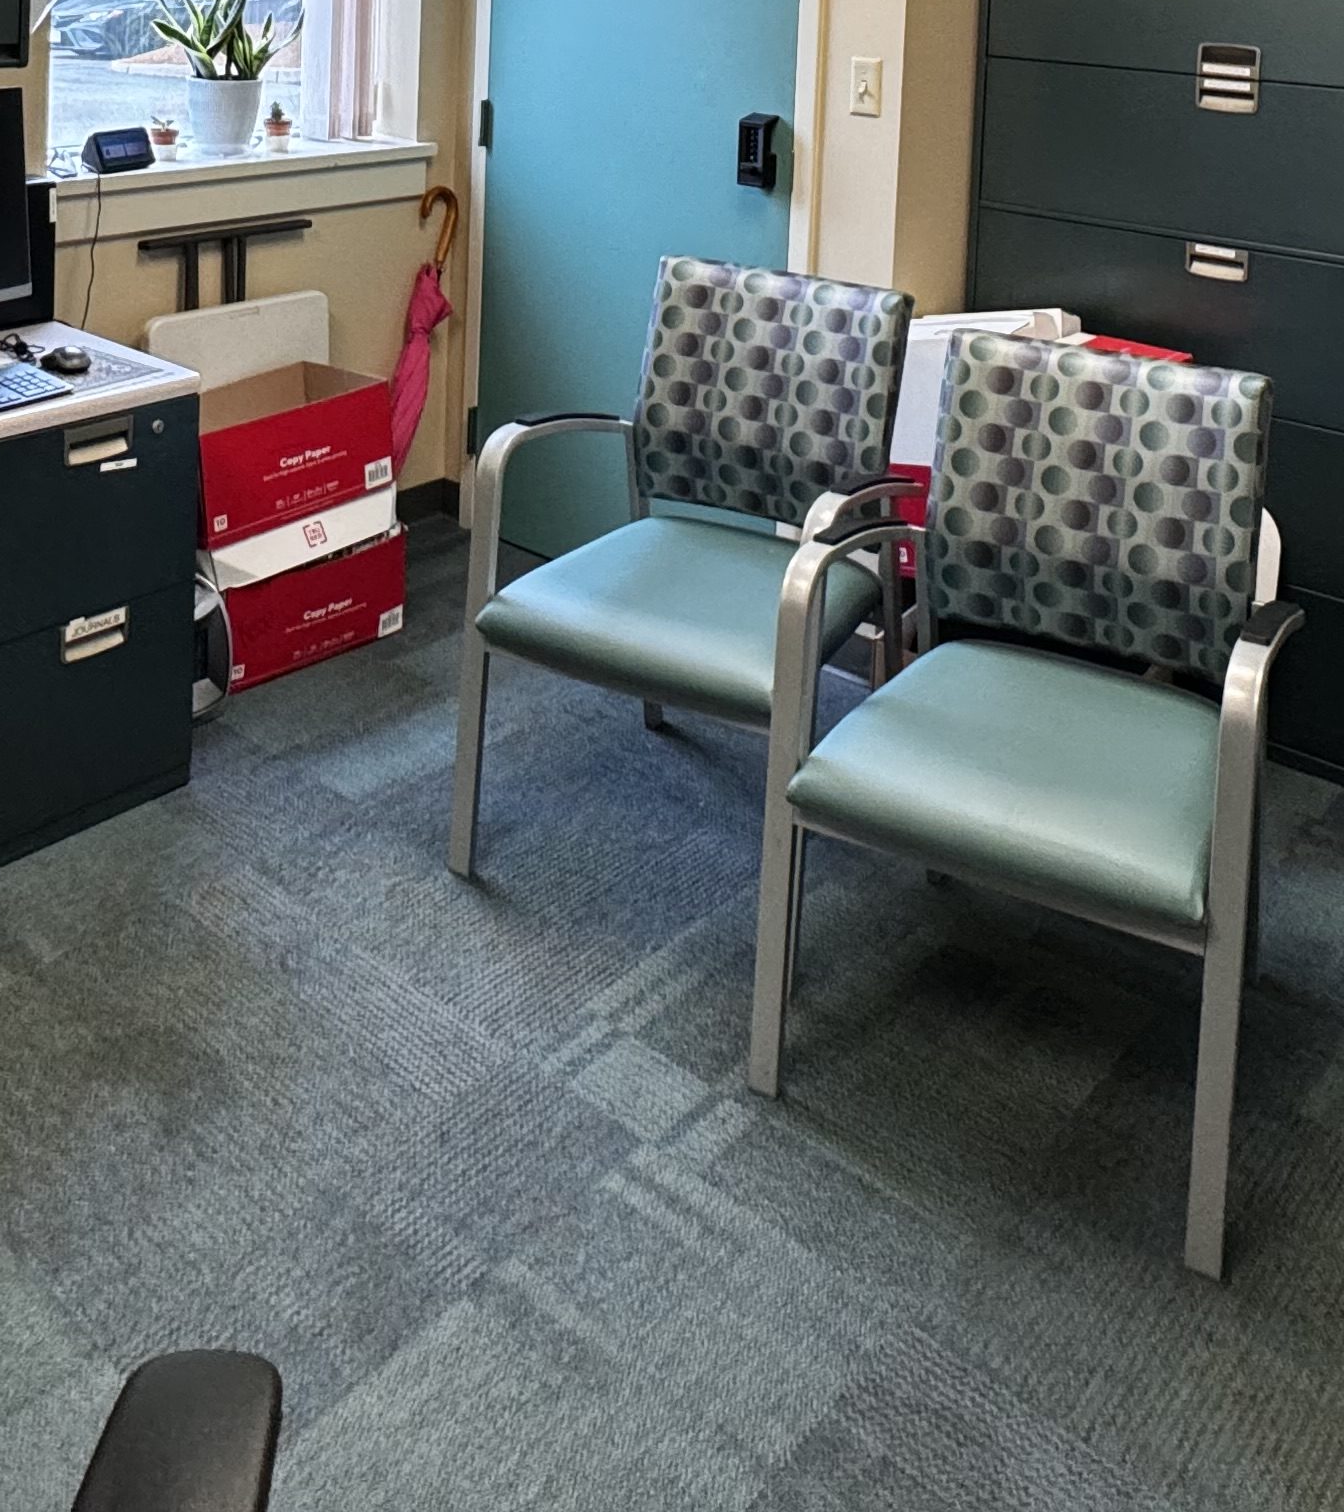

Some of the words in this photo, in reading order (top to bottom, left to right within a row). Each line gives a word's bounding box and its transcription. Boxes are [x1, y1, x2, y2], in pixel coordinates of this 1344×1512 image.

[279, 455, 304, 468] Copy
[305, 445, 332, 461] Paper
[216, 517, 226, 528] 10
[303, 607, 327, 621] Copy
[328, 597, 353, 614] Paper
[71, 614, 121, 638] JOURNALS
